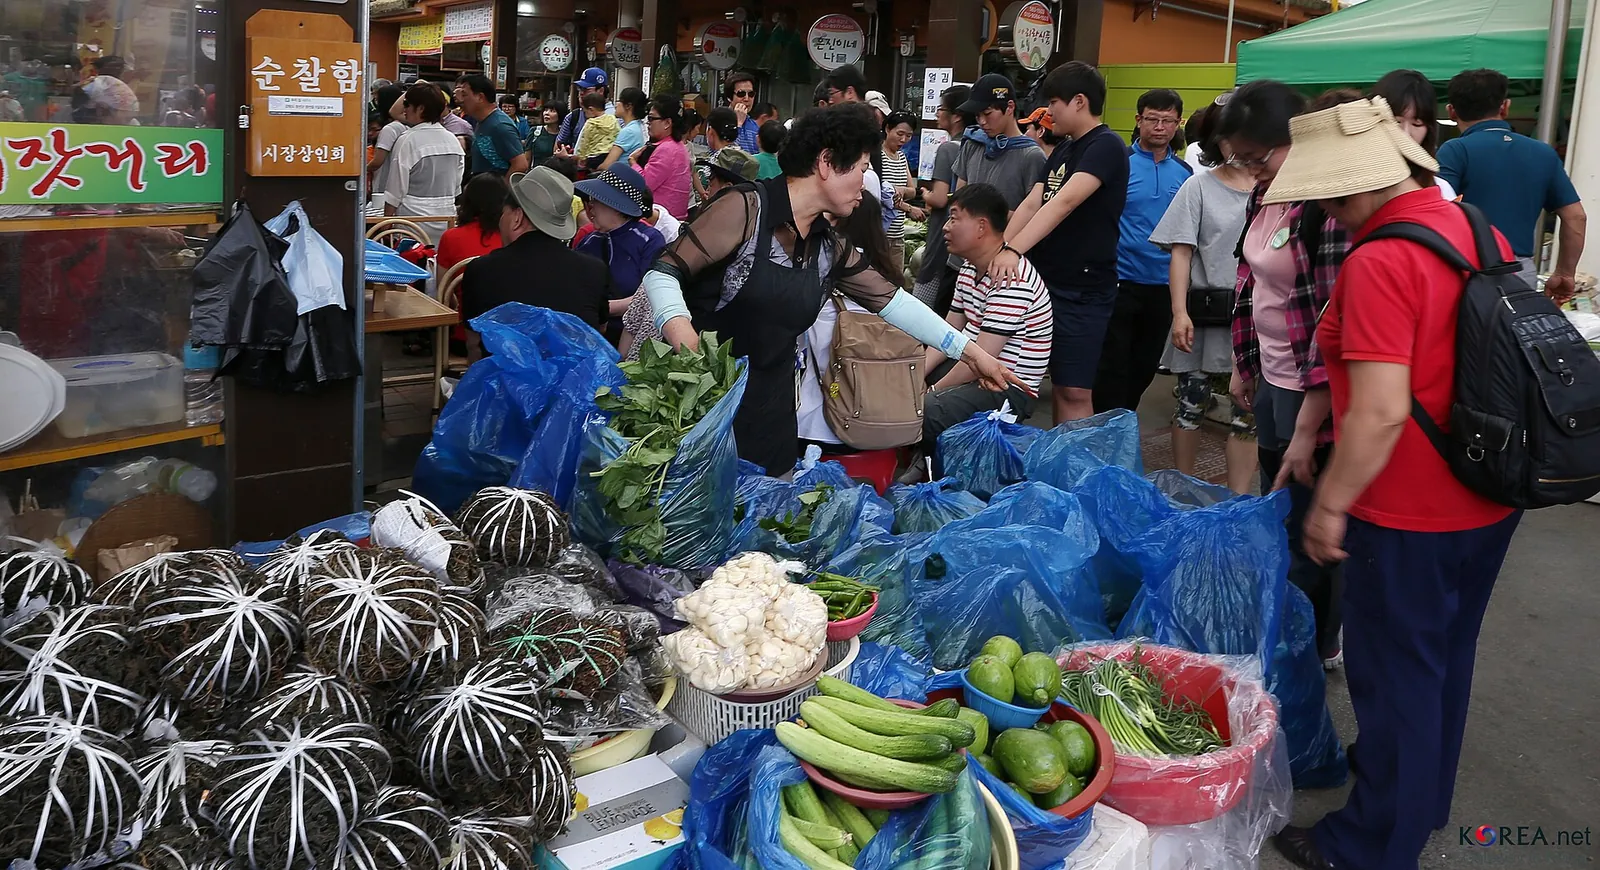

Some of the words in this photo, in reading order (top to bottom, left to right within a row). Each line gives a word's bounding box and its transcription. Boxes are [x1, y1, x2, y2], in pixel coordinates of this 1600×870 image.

[251, 56, 362, 94] 순찰함
[0, 129, 209, 197] 잣거리
[262, 144, 345, 163] 시장상인회
[583, 806, 615, 824] BLUE
[591, 803, 657, 832] LEMONADE
